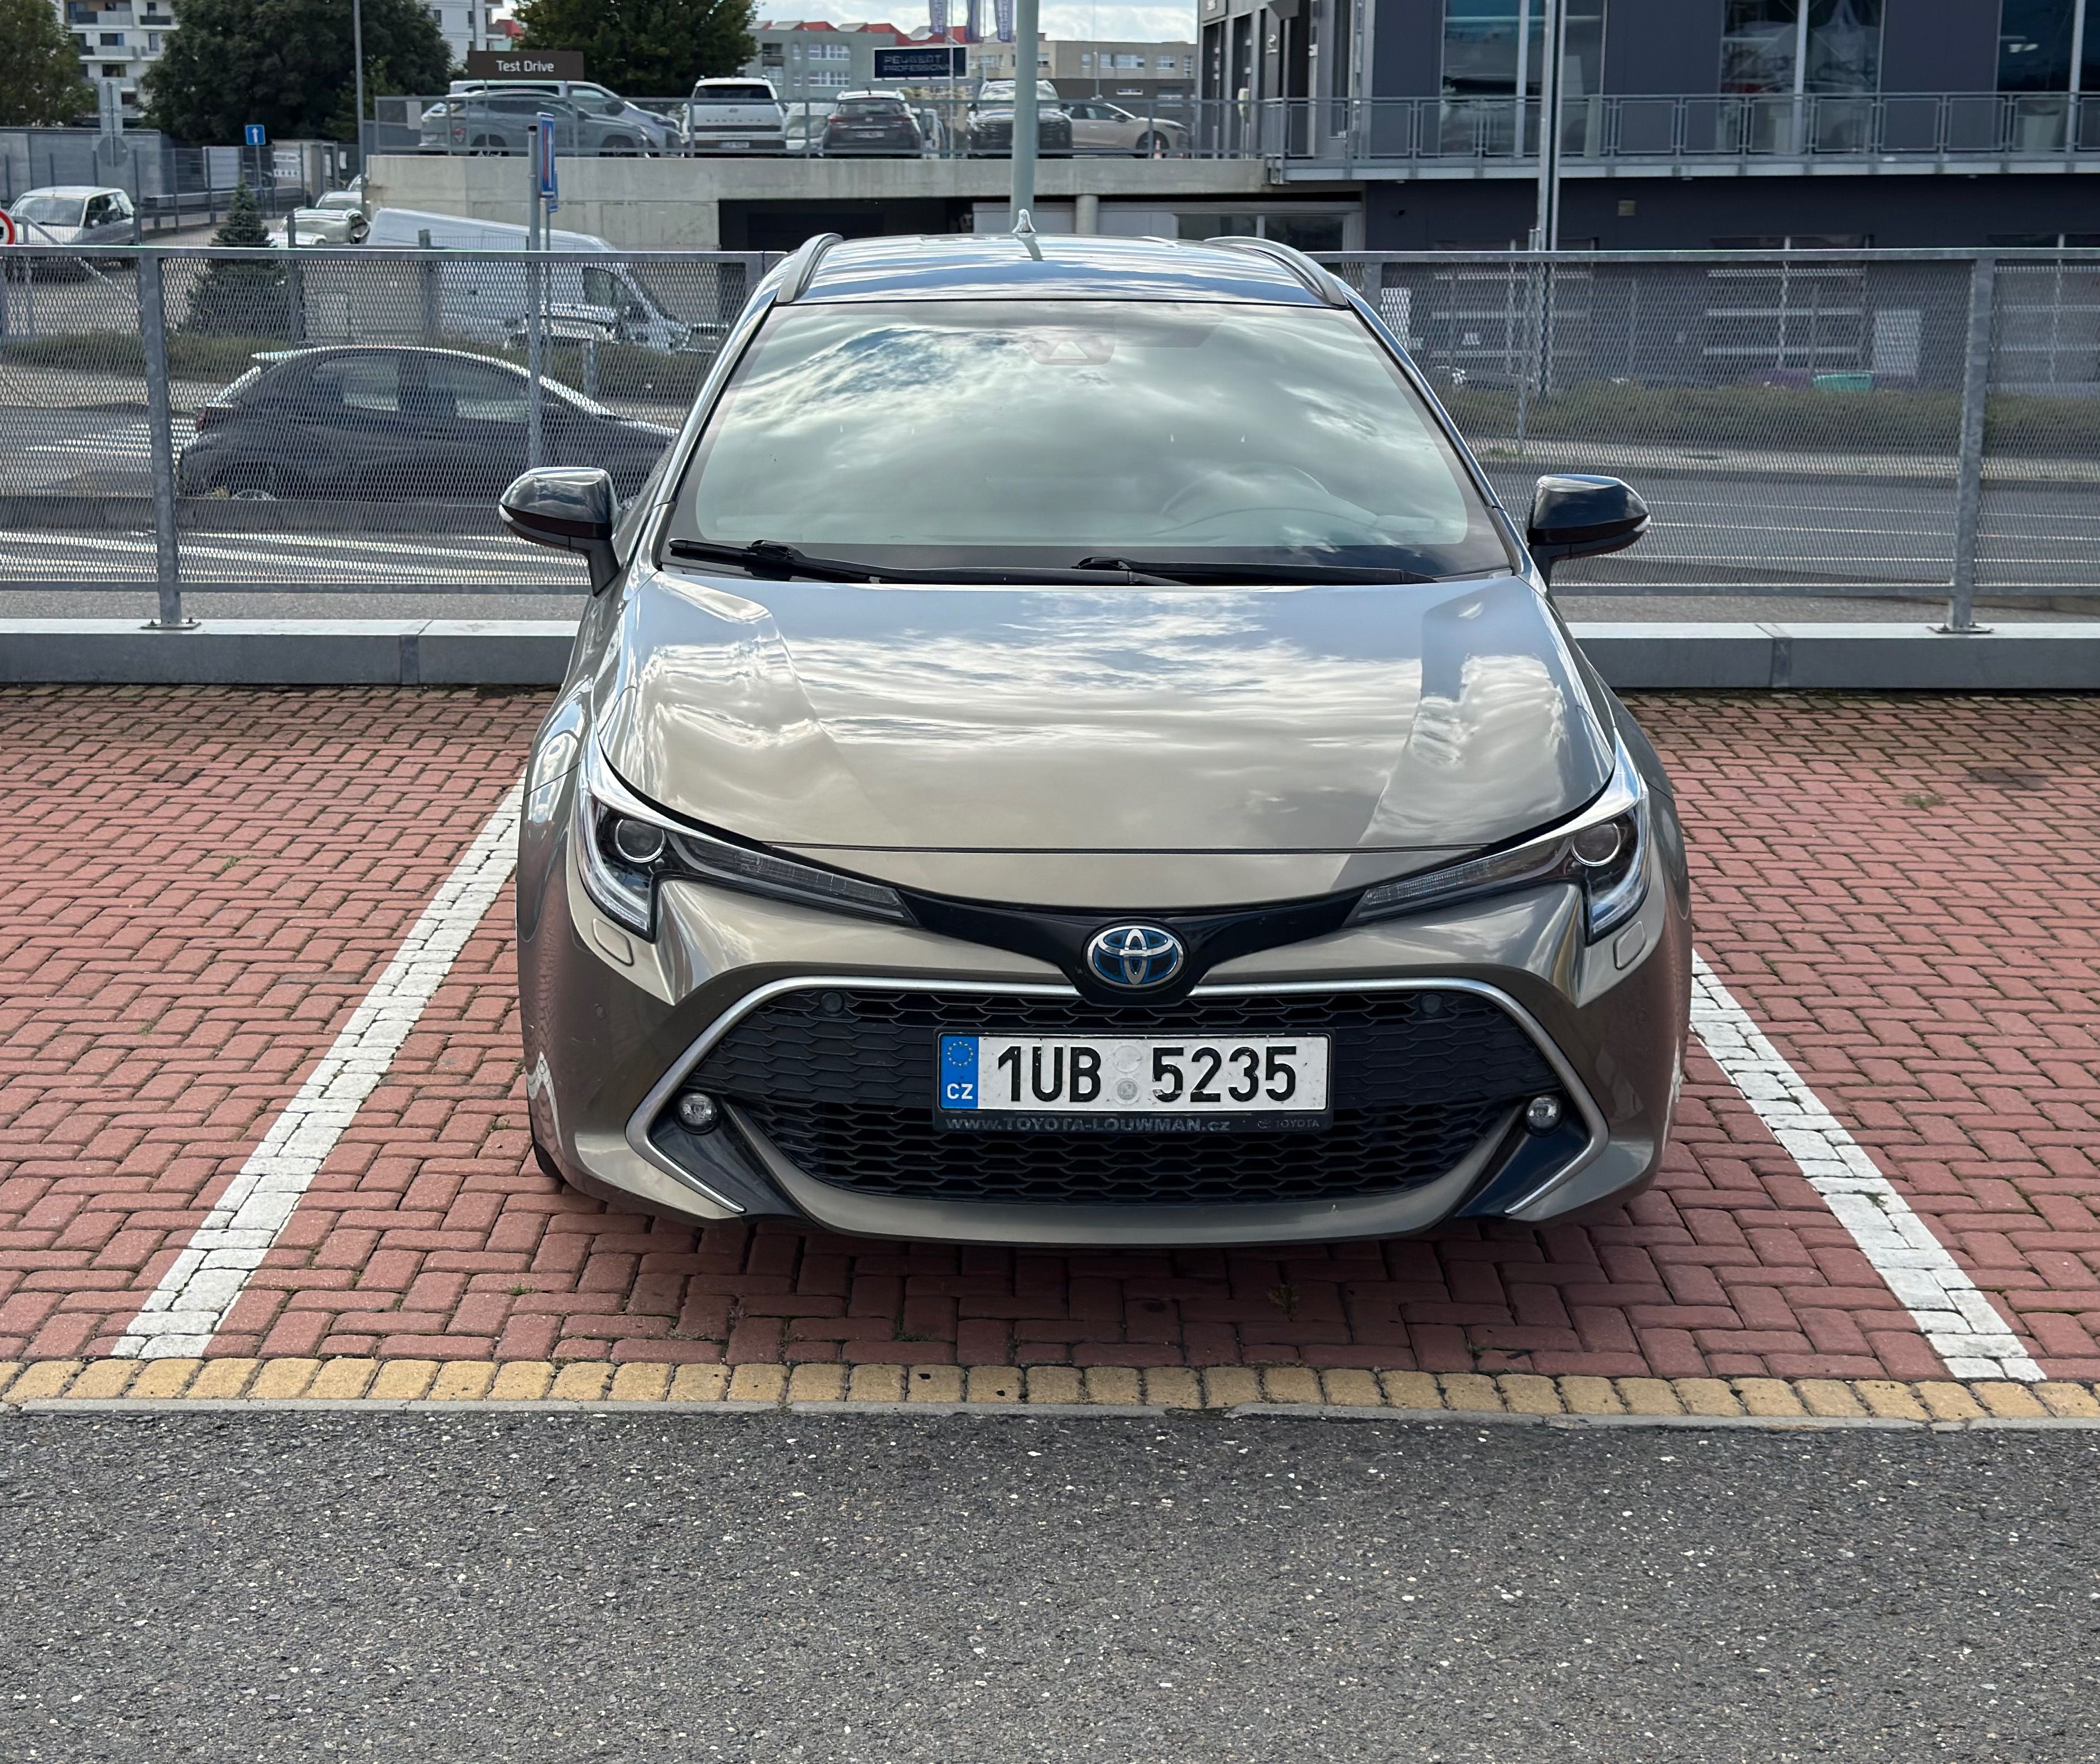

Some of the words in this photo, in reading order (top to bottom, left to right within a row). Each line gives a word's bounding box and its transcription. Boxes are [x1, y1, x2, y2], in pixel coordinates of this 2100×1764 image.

[883, 54, 942, 64] PEUGEOT
[496, 60, 521, 72] Test
[523, 60, 554, 72] Drive
[998, 1046, 1102, 1103] 1UB
[1152, 1046, 1297, 1103] 5235
[946, 1083, 973, 1099] CZ
[1276, 1118, 1320, 1128] TOYOTA
